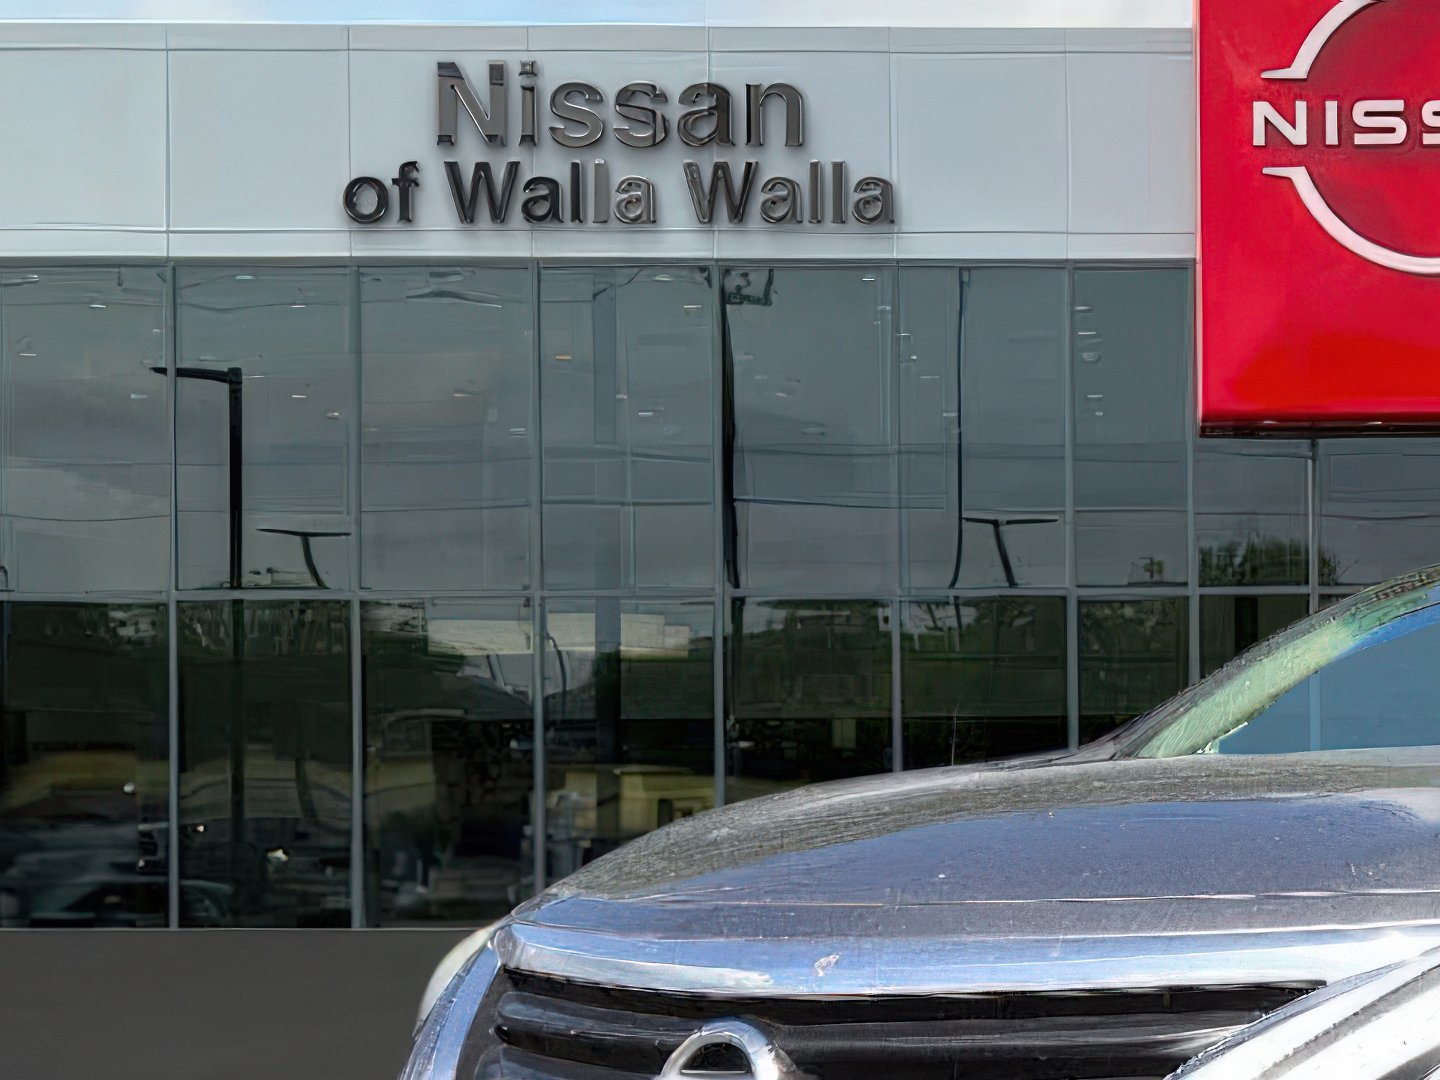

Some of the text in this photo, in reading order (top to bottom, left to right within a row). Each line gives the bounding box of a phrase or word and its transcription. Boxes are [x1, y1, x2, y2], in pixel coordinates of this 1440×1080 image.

[437, 60, 804, 147] Nissan
[342, 159, 895, 224] of Walla Walla
